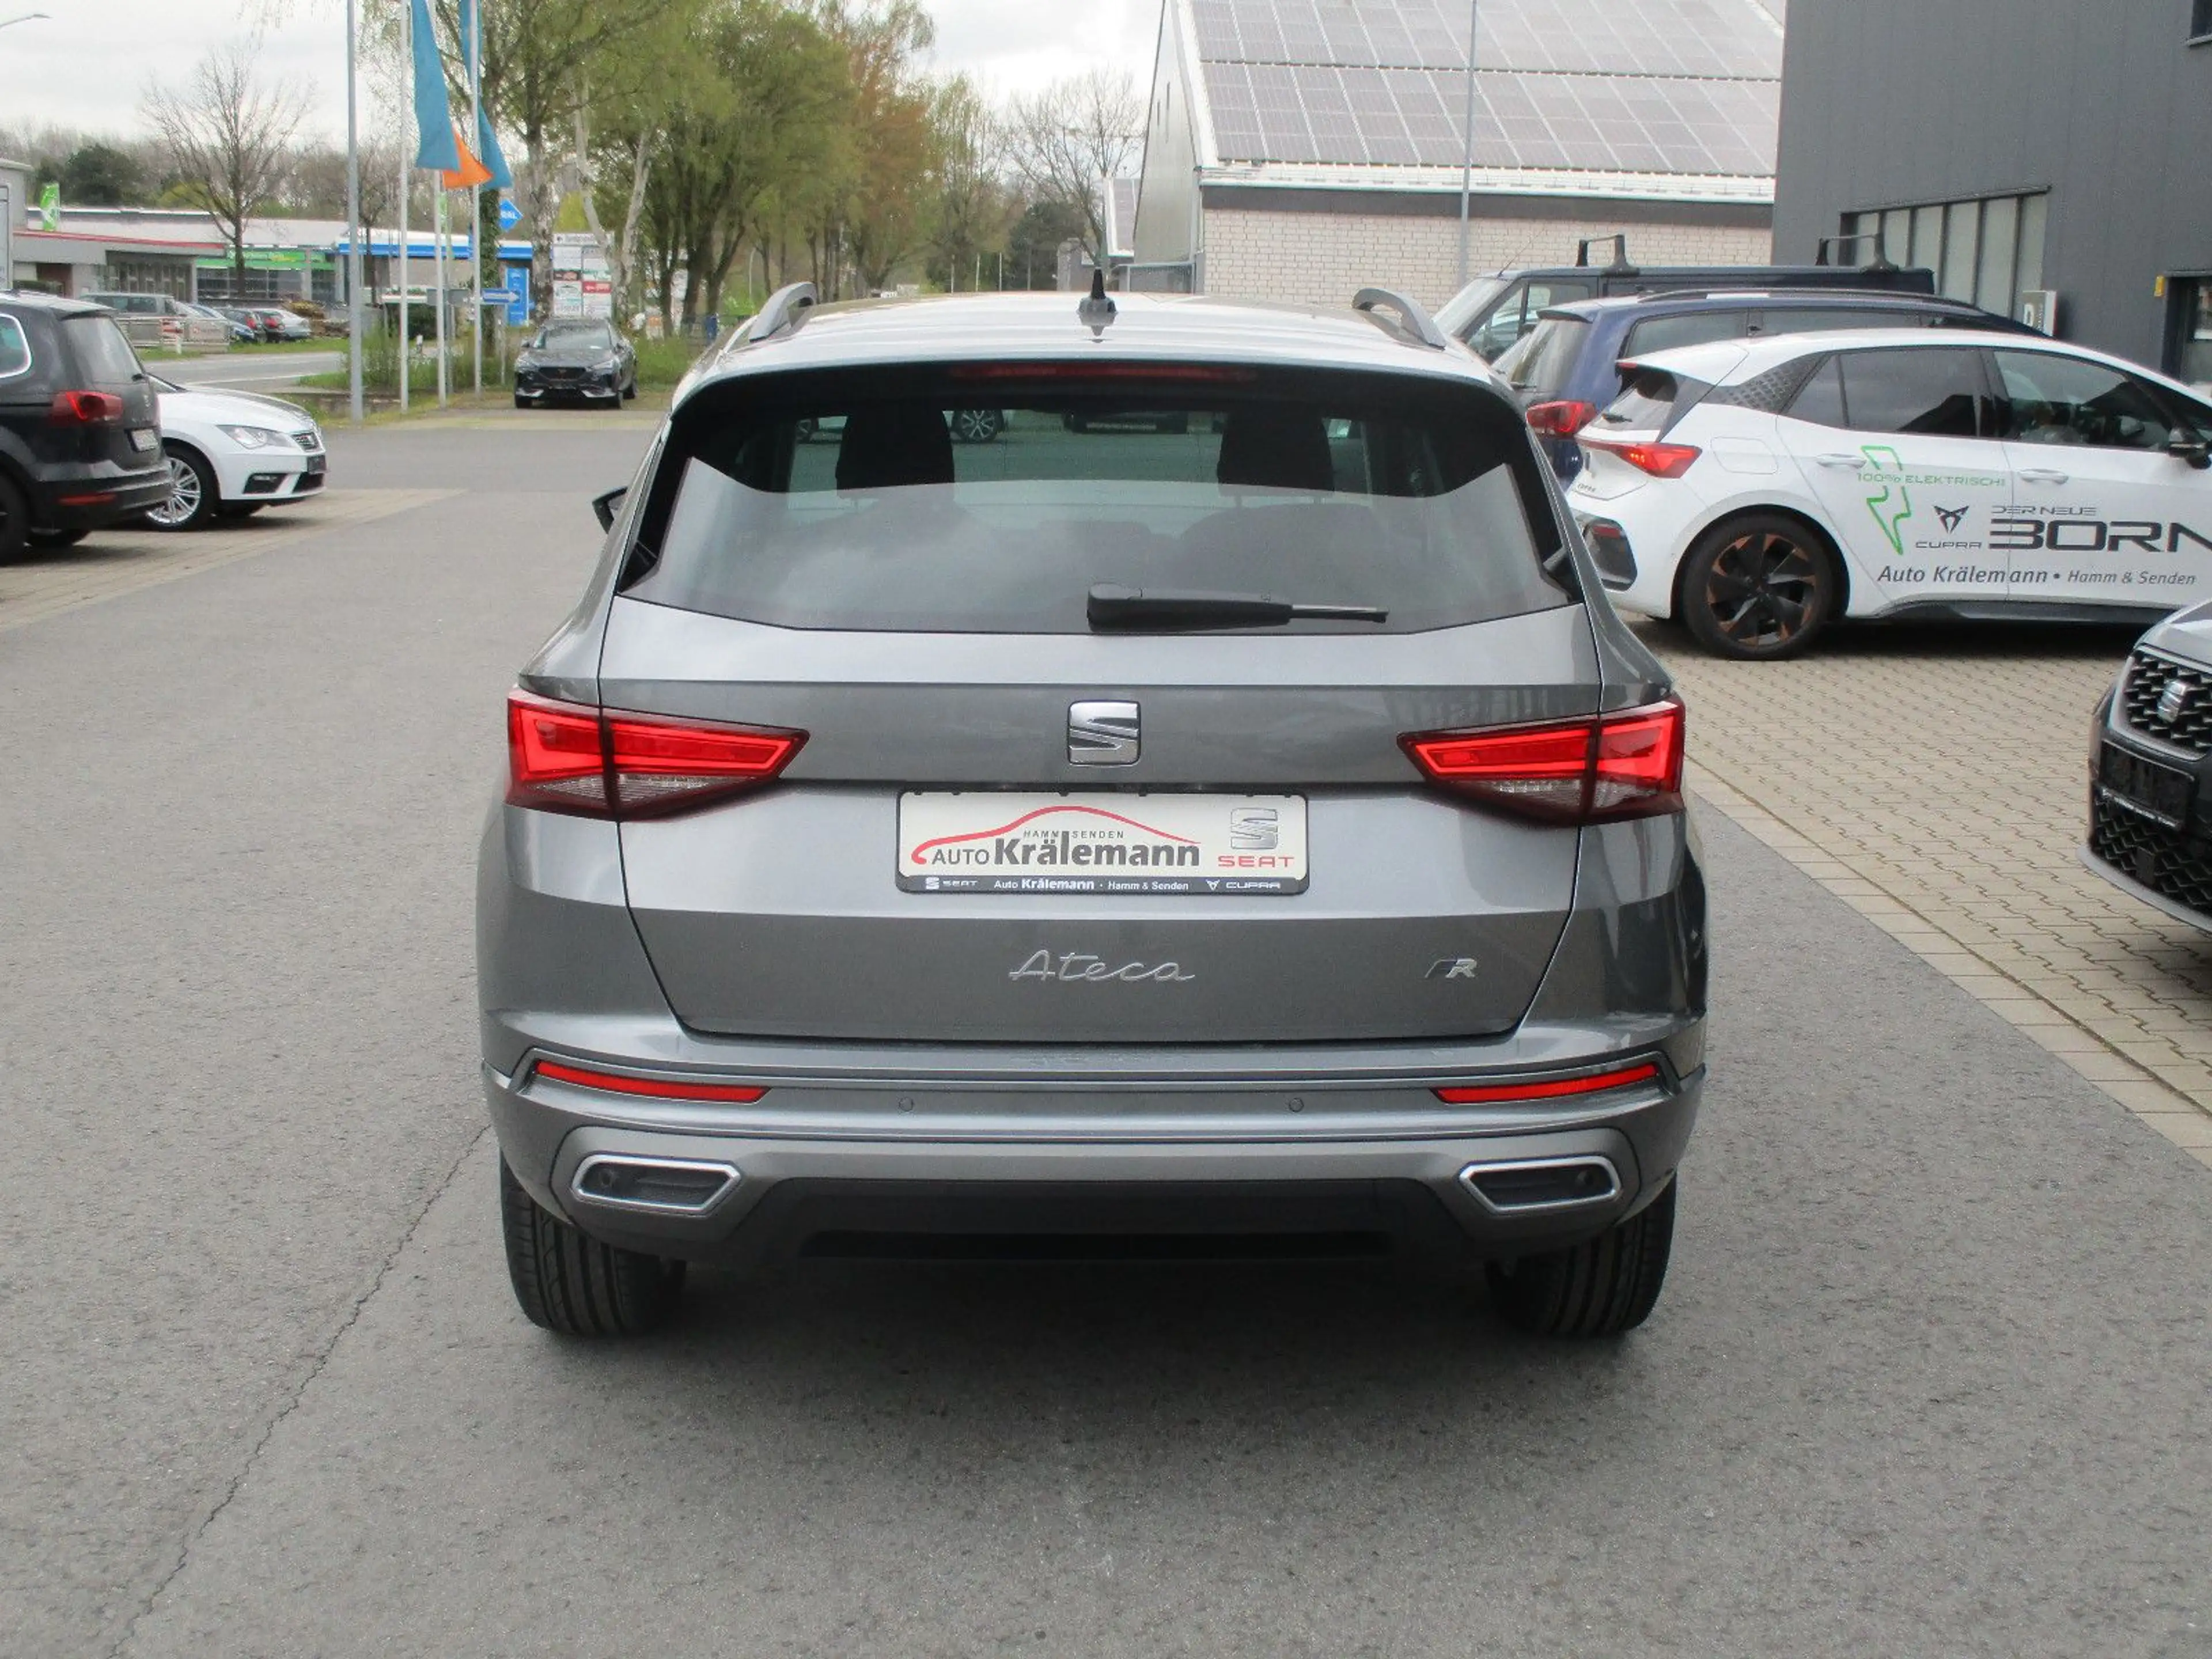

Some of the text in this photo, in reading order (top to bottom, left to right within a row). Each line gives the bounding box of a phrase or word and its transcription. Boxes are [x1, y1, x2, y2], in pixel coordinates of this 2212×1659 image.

[1857, 473, 1901, 482] 100%
[1877, 565, 2196, 585] Auto Krälemann Hamm & Senden
[931, 831, 1199, 866] AUTO Krälemann
[1218, 855, 1294, 867] SEAT
[994, 880, 1018, 889] Auto
[1021, 878, 1094, 890] Krälemann
[1108, 881, 1139, 890] Hamm
[1142, 882, 1148, 890] &
[1152, 881, 1188, 890] Senden
[1009, 950, 1195, 980] Ateca
